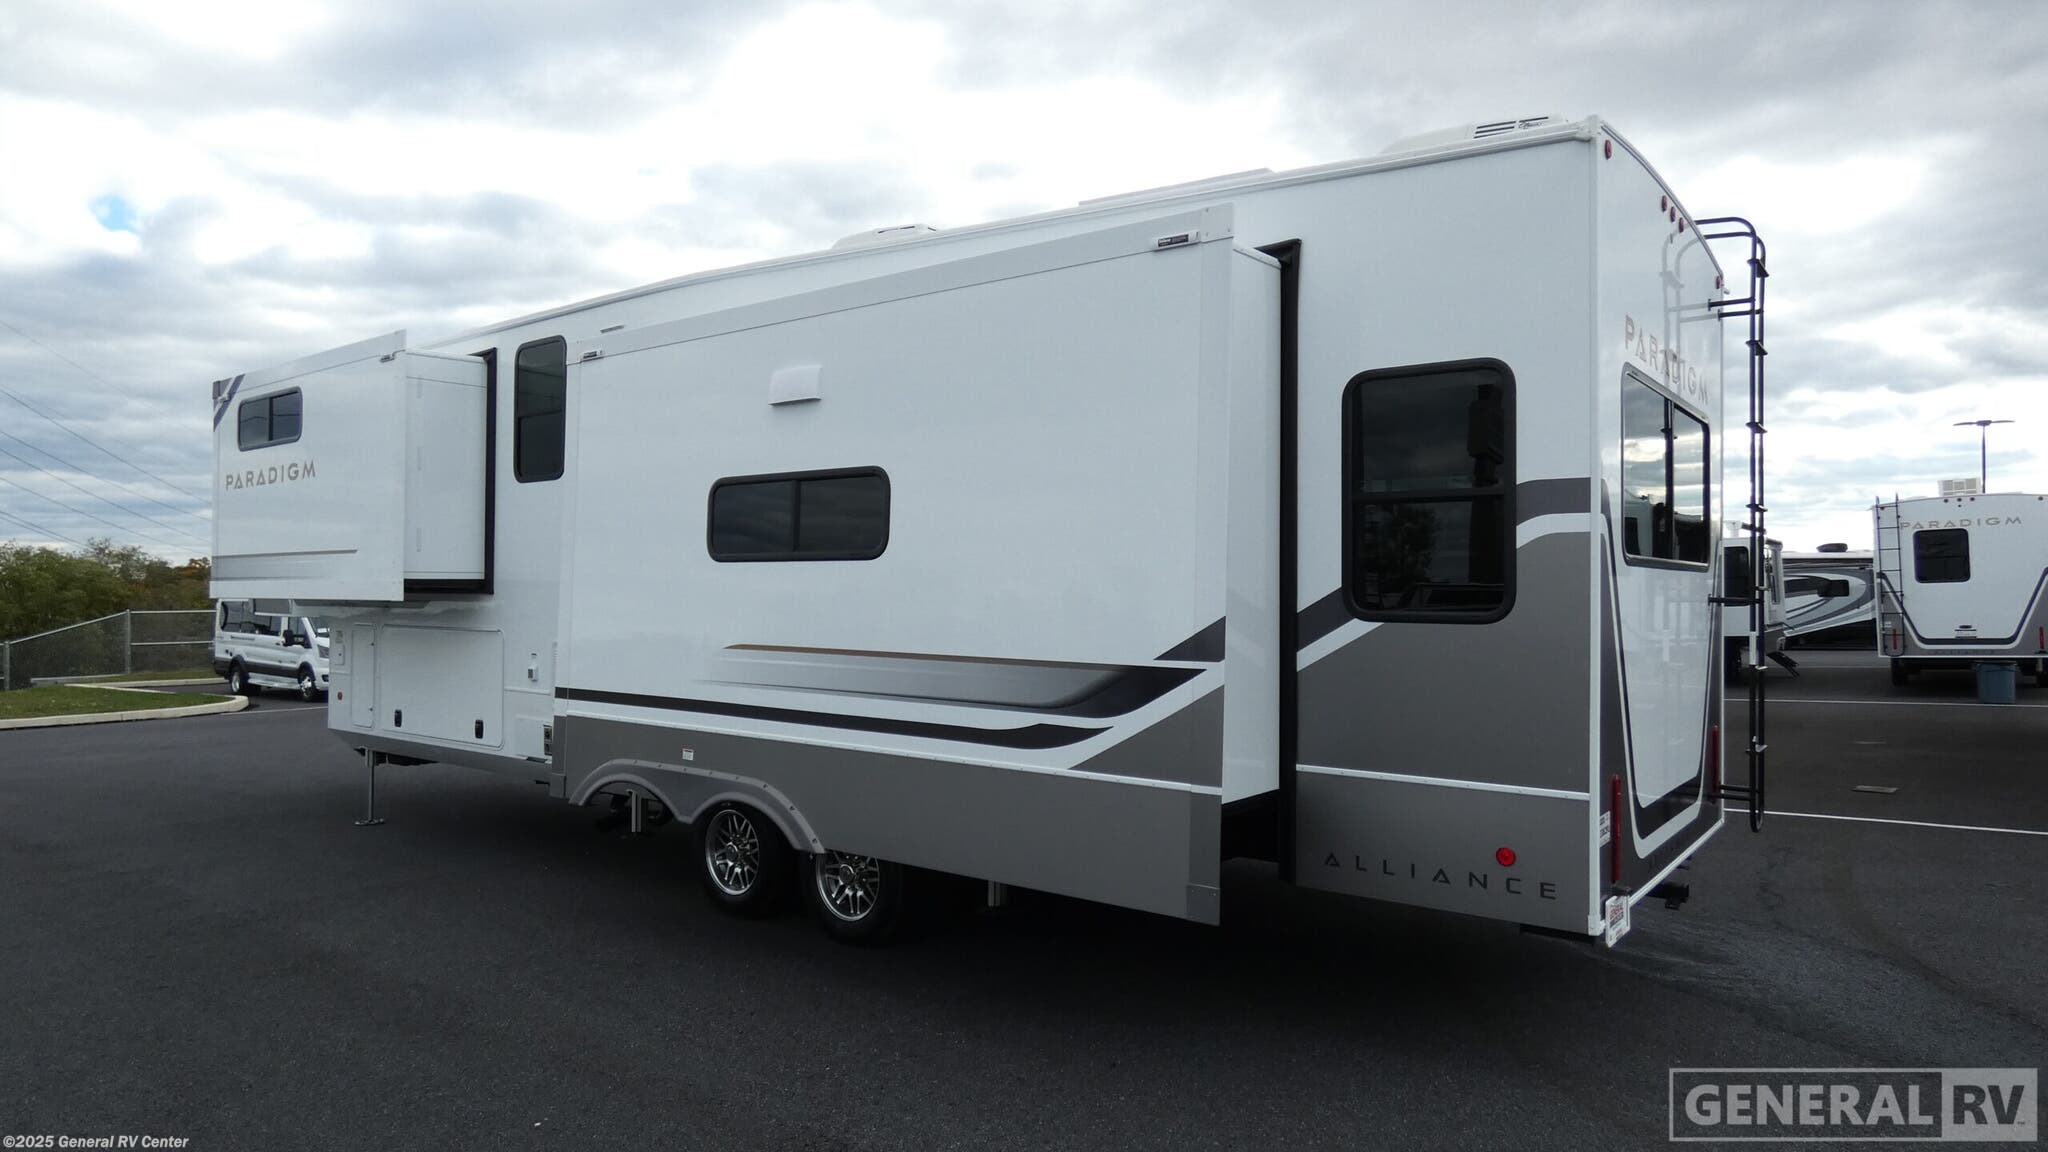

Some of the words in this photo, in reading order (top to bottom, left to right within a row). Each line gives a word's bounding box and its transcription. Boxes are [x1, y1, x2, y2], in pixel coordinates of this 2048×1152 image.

[1624, 314, 1709, 405] PARADIGM
[225, 459, 316, 491] PARADIGM
[1900, 515, 2022, 530] PARADIGM
[1324, 852, 1557, 900] ALLIANCE
